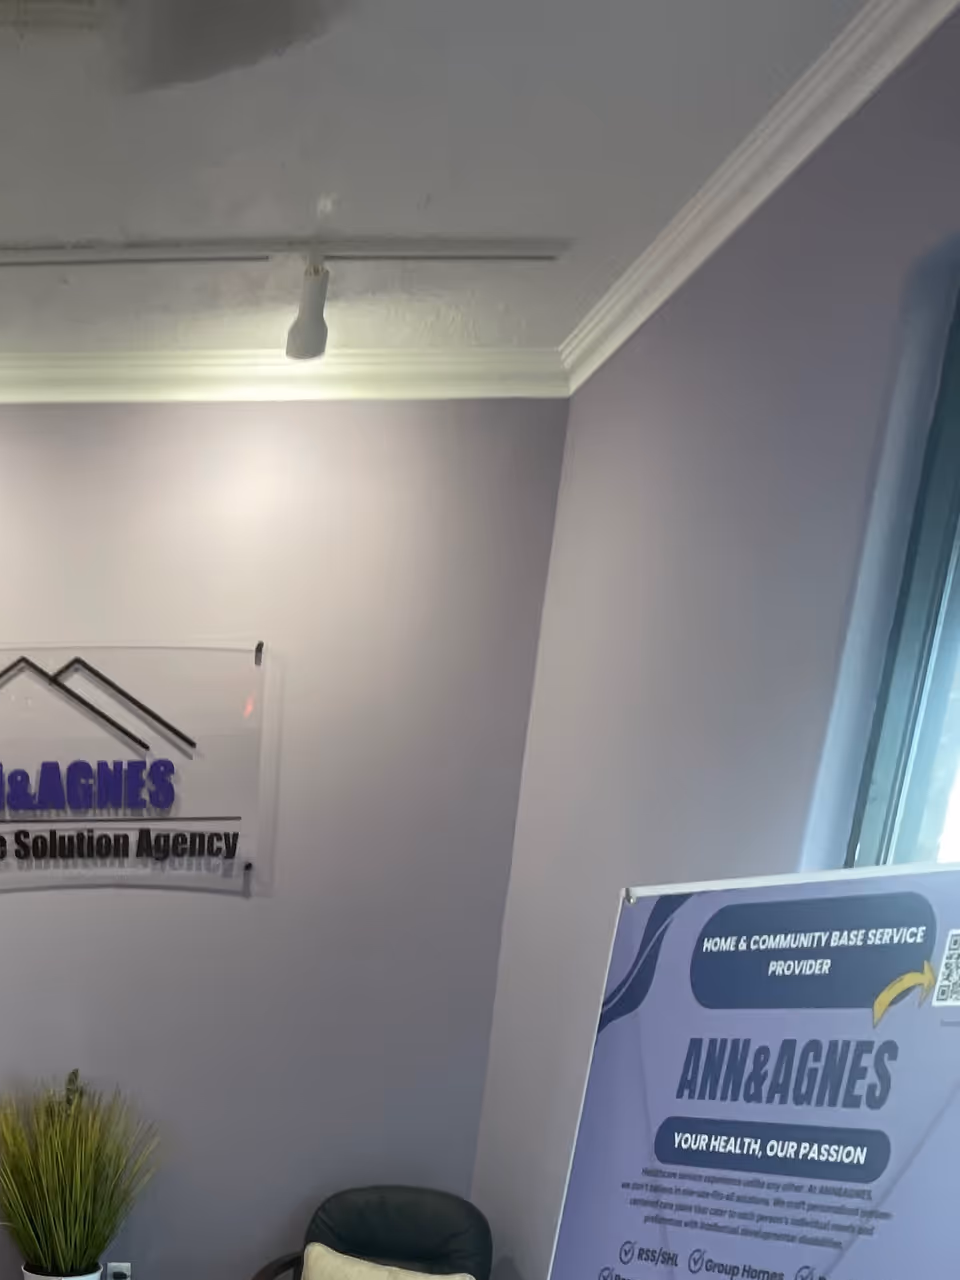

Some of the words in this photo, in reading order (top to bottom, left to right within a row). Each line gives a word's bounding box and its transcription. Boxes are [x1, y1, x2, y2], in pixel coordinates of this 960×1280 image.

[14, 828, 129, 860] Solution
[136, 828, 240, 861] Agency
[702, 935, 738, 952] HOME
[738, 935, 747, 951] &
[750, 931, 829, 950] COMMUNITY
[830, 929, 865, 947] BASE
[867, 926, 927, 945] SERVICE
[768, 959, 831, 976] PROVIDER
[676, 1037, 899, 1110] ANN&AGNES
[673, 1131, 709, 1151] YOUR
[709, 1135, 762, 1159] HEALTH,
[766, 1139, 797, 1159] OUR
[798, 1142, 867, 1165] PASSION
[705, 1258, 740, 1280] Group
